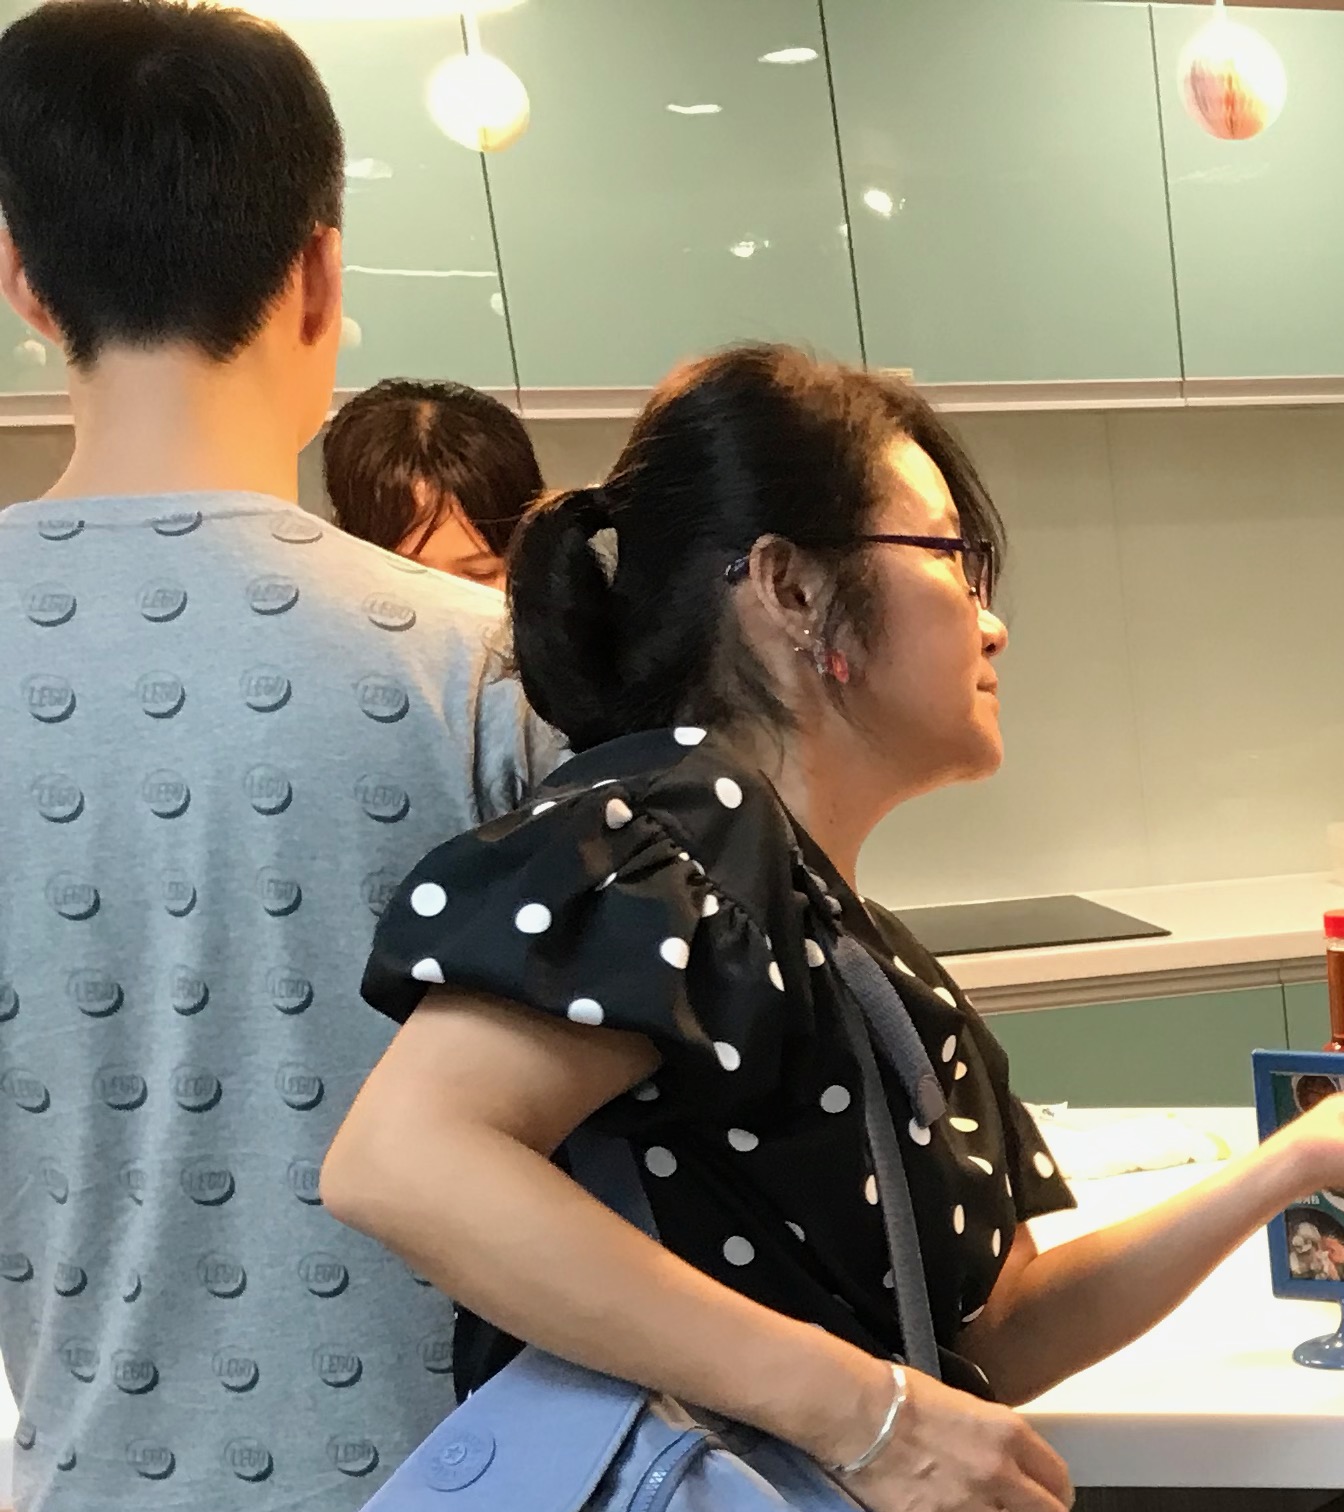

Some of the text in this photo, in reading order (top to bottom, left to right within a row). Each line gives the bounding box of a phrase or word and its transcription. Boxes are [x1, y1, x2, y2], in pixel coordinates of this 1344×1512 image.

[28, 685, 70, 707] LEGO
[204, 1263, 242, 1284] LEGO
[306, 1263, 344, 1284] LEGO
[113, 1361, 151, 1381] LEGO
[319, 1353, 358, 1374] LEGO
